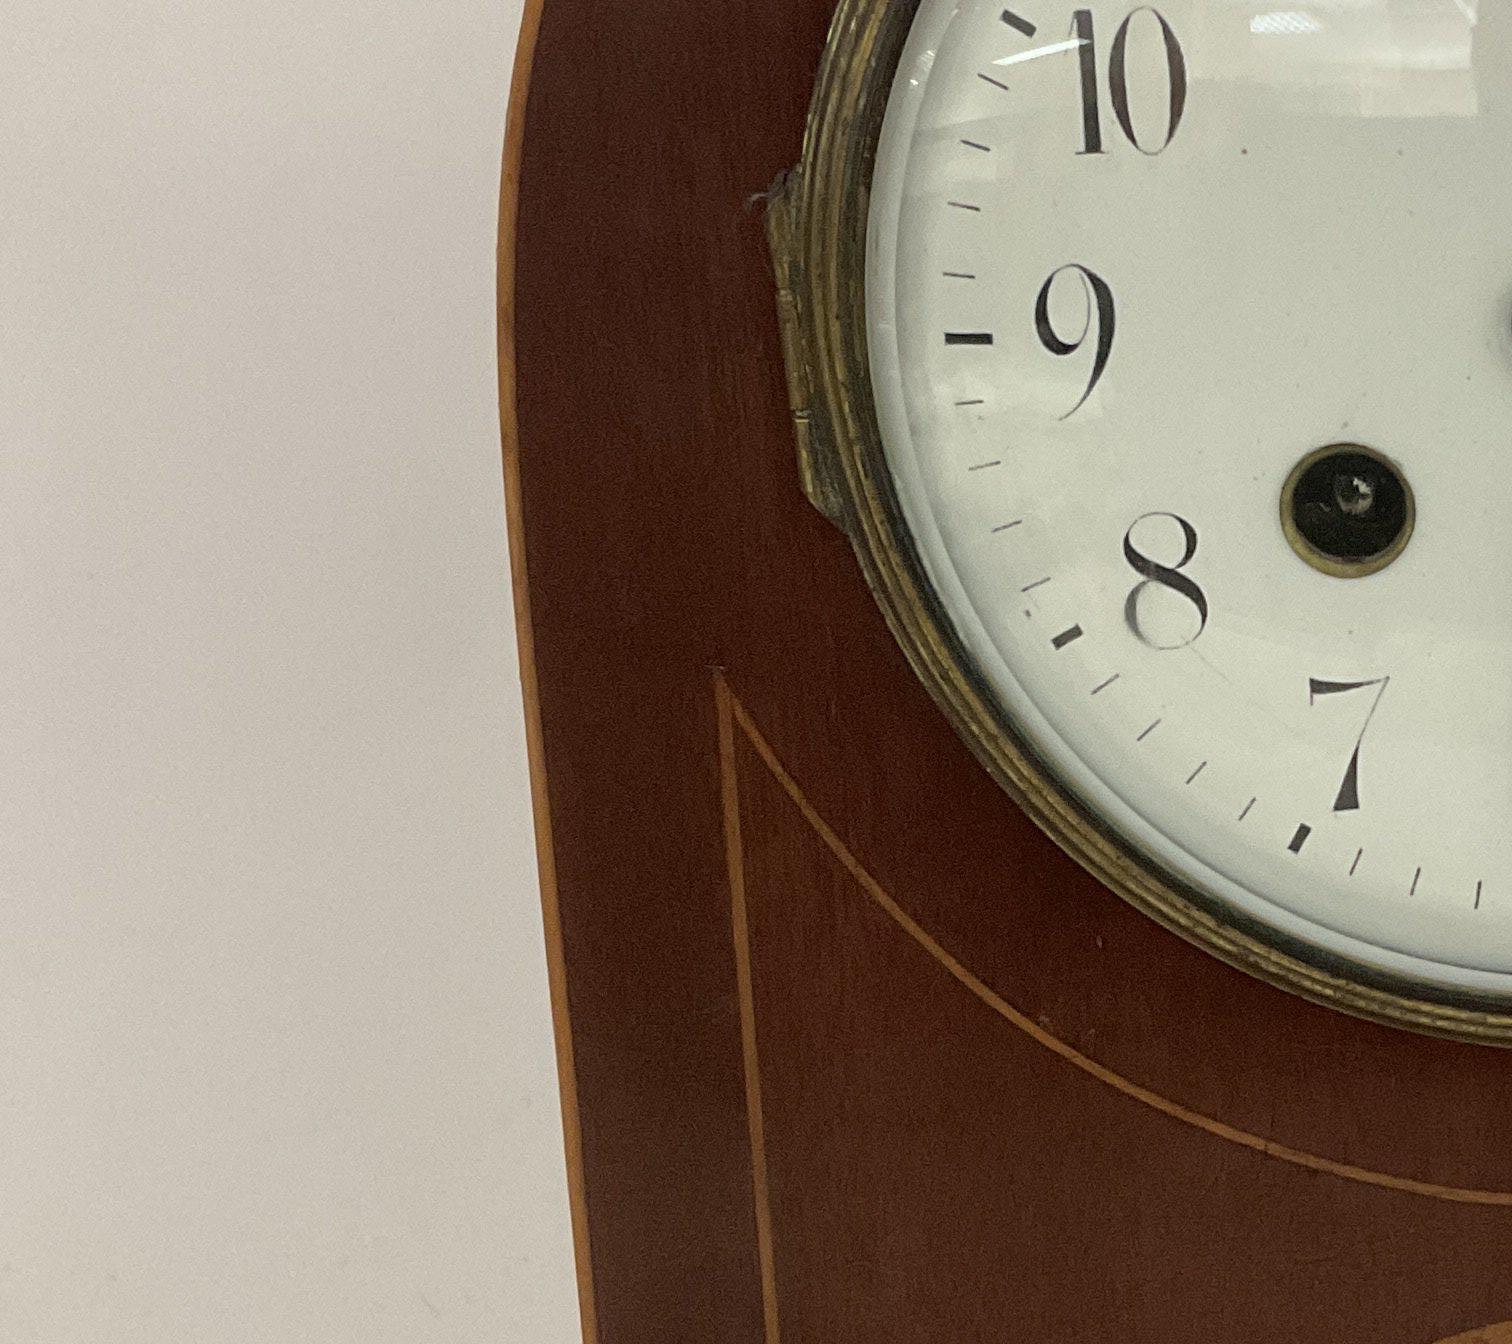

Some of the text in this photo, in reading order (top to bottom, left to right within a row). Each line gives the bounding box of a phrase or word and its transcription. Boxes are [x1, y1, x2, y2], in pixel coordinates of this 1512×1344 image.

[1067, 6, 1189, 156] 10
[1034, 262, 1117, 422] 9
[1122, 511, 1209, 652] 8
[1308, 674, 1391, 813] 7
